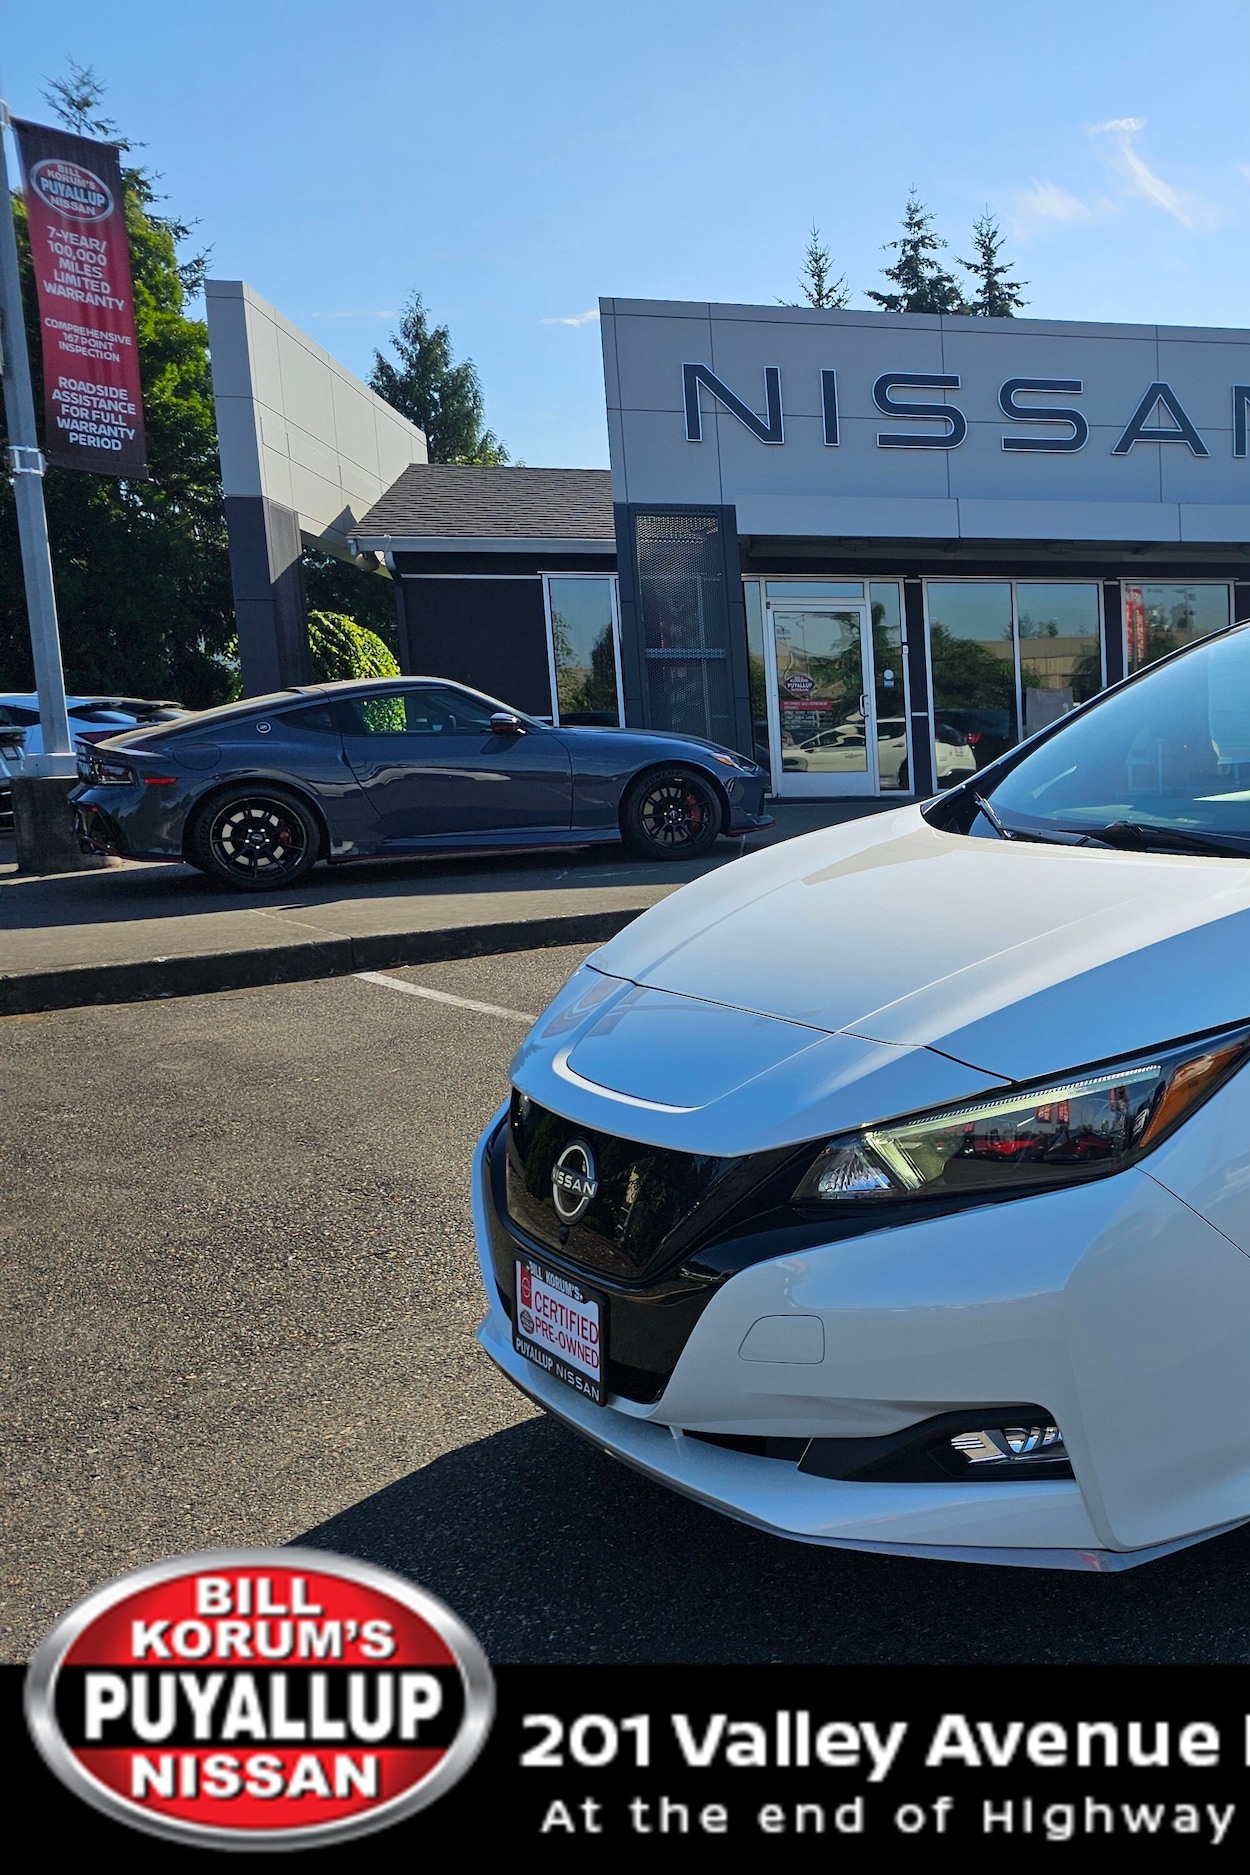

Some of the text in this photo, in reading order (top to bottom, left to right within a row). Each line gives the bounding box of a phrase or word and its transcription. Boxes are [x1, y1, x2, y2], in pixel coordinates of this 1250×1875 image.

[47, 169, 96, 190] KORUM'S
[57, 164, 81, 177] BILL
[40, 177, 106, 207] PUYALLUP
[50, 196, 96, 215] NISSAN
[47, 226, 107, 253] 7-YEAR/
[47, 240, 107, 266] 100,000
[59, 257, 103, 278] MILES
[53, 269, 111, 294] LIMITED
[43, 280, 125, 311] WARRANTY
[44, 317, 132, 345] COMPREHENSIVE
[62, 332, 114, 351] 167 POINT
[59, 341, 120, 362] INSPECTION
[58, 376, 128, 400] ROADSIDE
[51, 389, 136, 415] ASSISTANCE
[61, 404, 127, 426] FOR FULL
[56, 416, 135, 440] WARRANTY
[69, 432, 122, 451] PERIOD
[545, 1270, 581, 1301] KORUM'S
[534, 1290, 599, 1345] CERTIFIED
[535, 1316, 599, 1369] PRE-OWNED
[515, 1337, 600, 1402] PUYALLUP NISSAN
